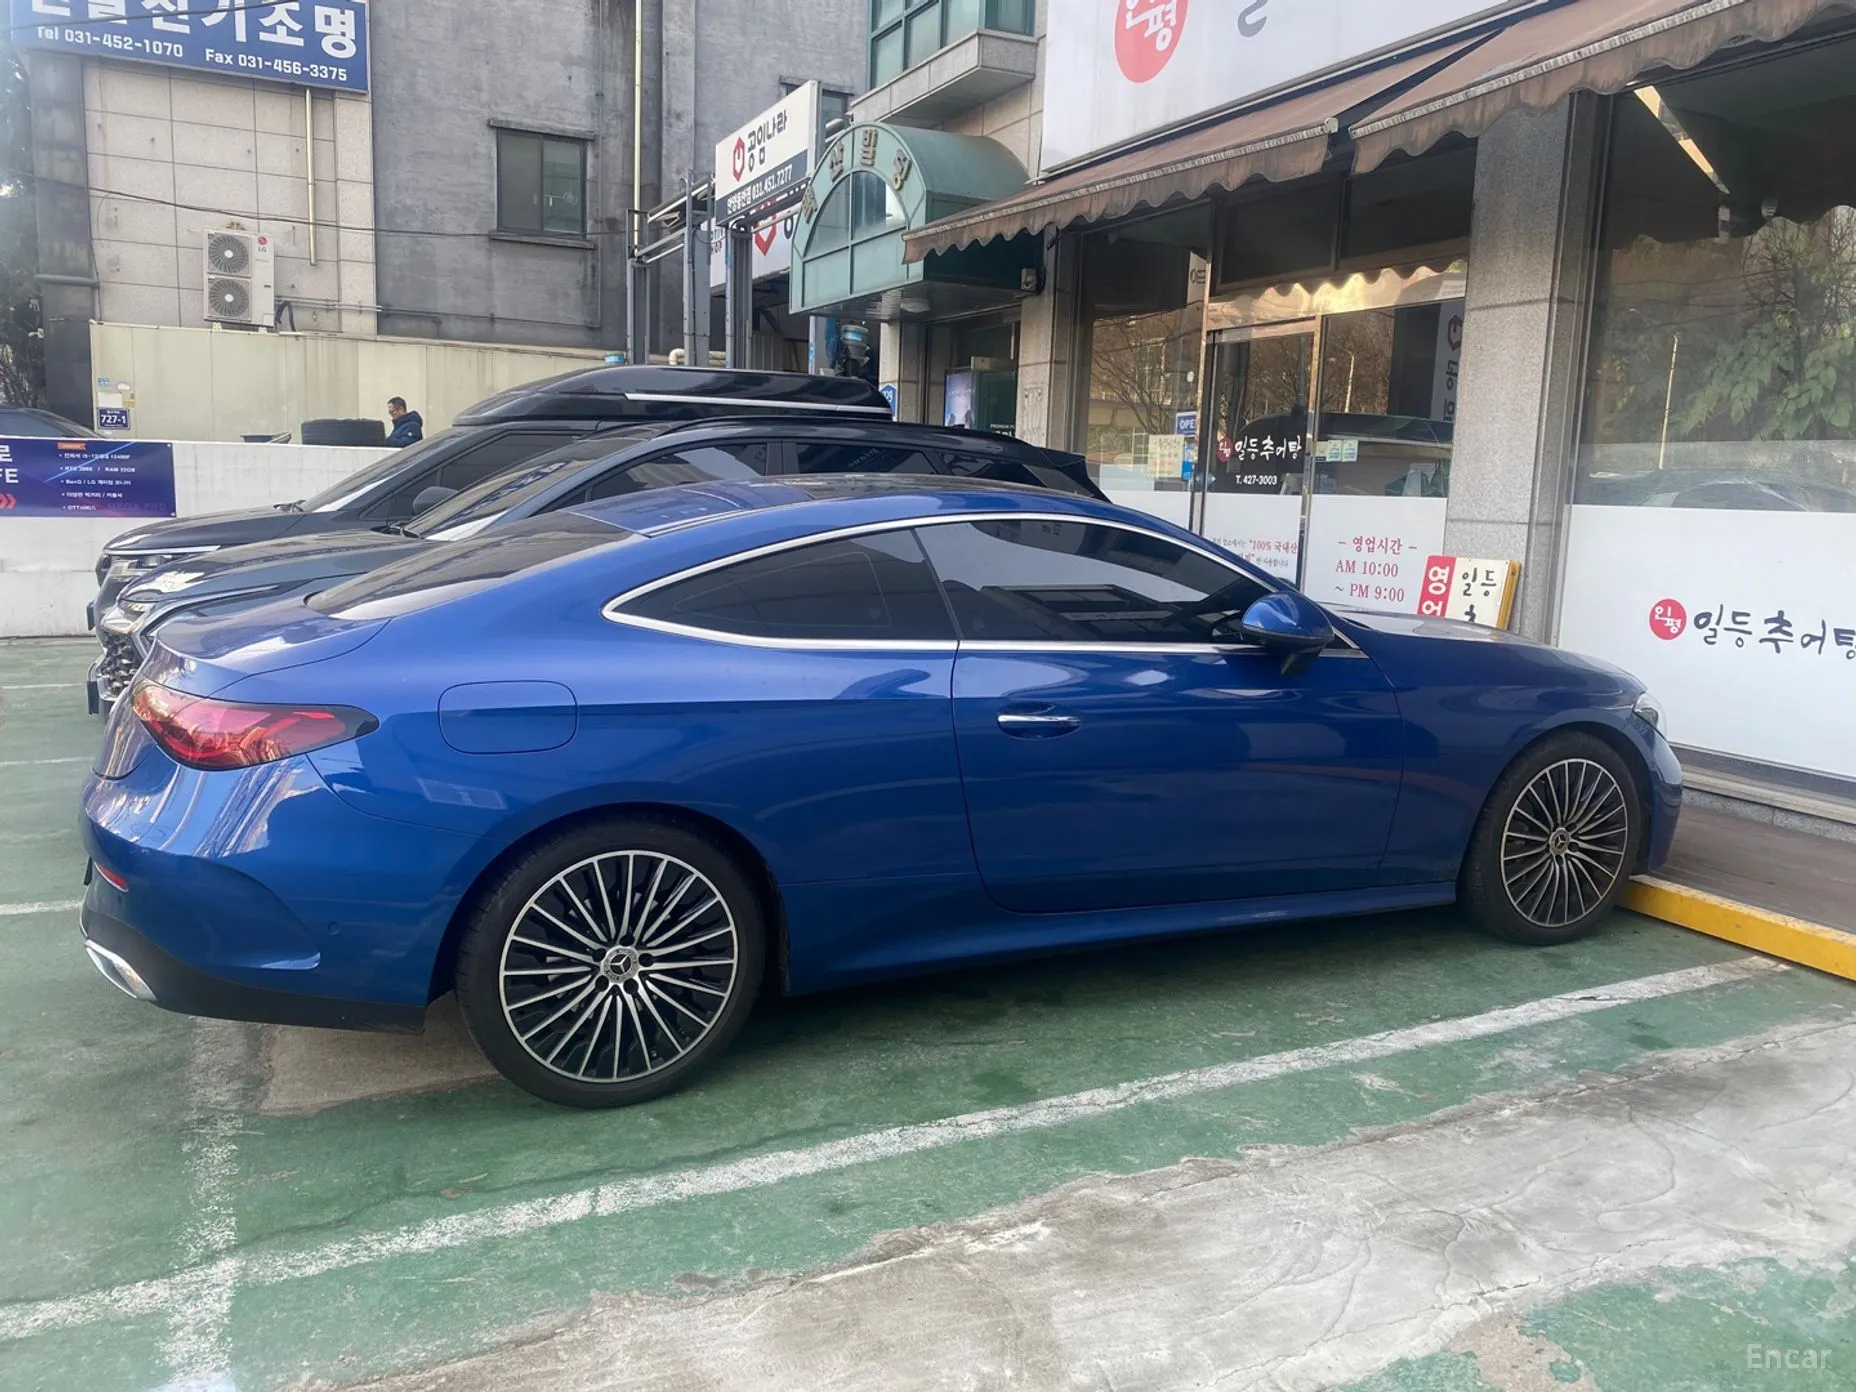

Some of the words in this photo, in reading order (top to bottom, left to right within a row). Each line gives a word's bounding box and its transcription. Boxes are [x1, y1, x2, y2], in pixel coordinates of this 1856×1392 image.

[37, 26, 59, 40] Tel
[65, 29, 183, 57] 031-452-1070
[205, 49, 233, 65] Fax
[238, 54, 347, 81] 031-456-3375
[101, 415, 126, 424] 727-1
[1352, 536, 1402, 555] 영업시간
[1335, 559, 1356, 573] AM
[1361, 561, 1399, 577] 10:00
[1462, 567, 1497, 597] 일등
[1350, 583, 1369, 598] PM
[1374, 585, 1404, 602] 9:00
